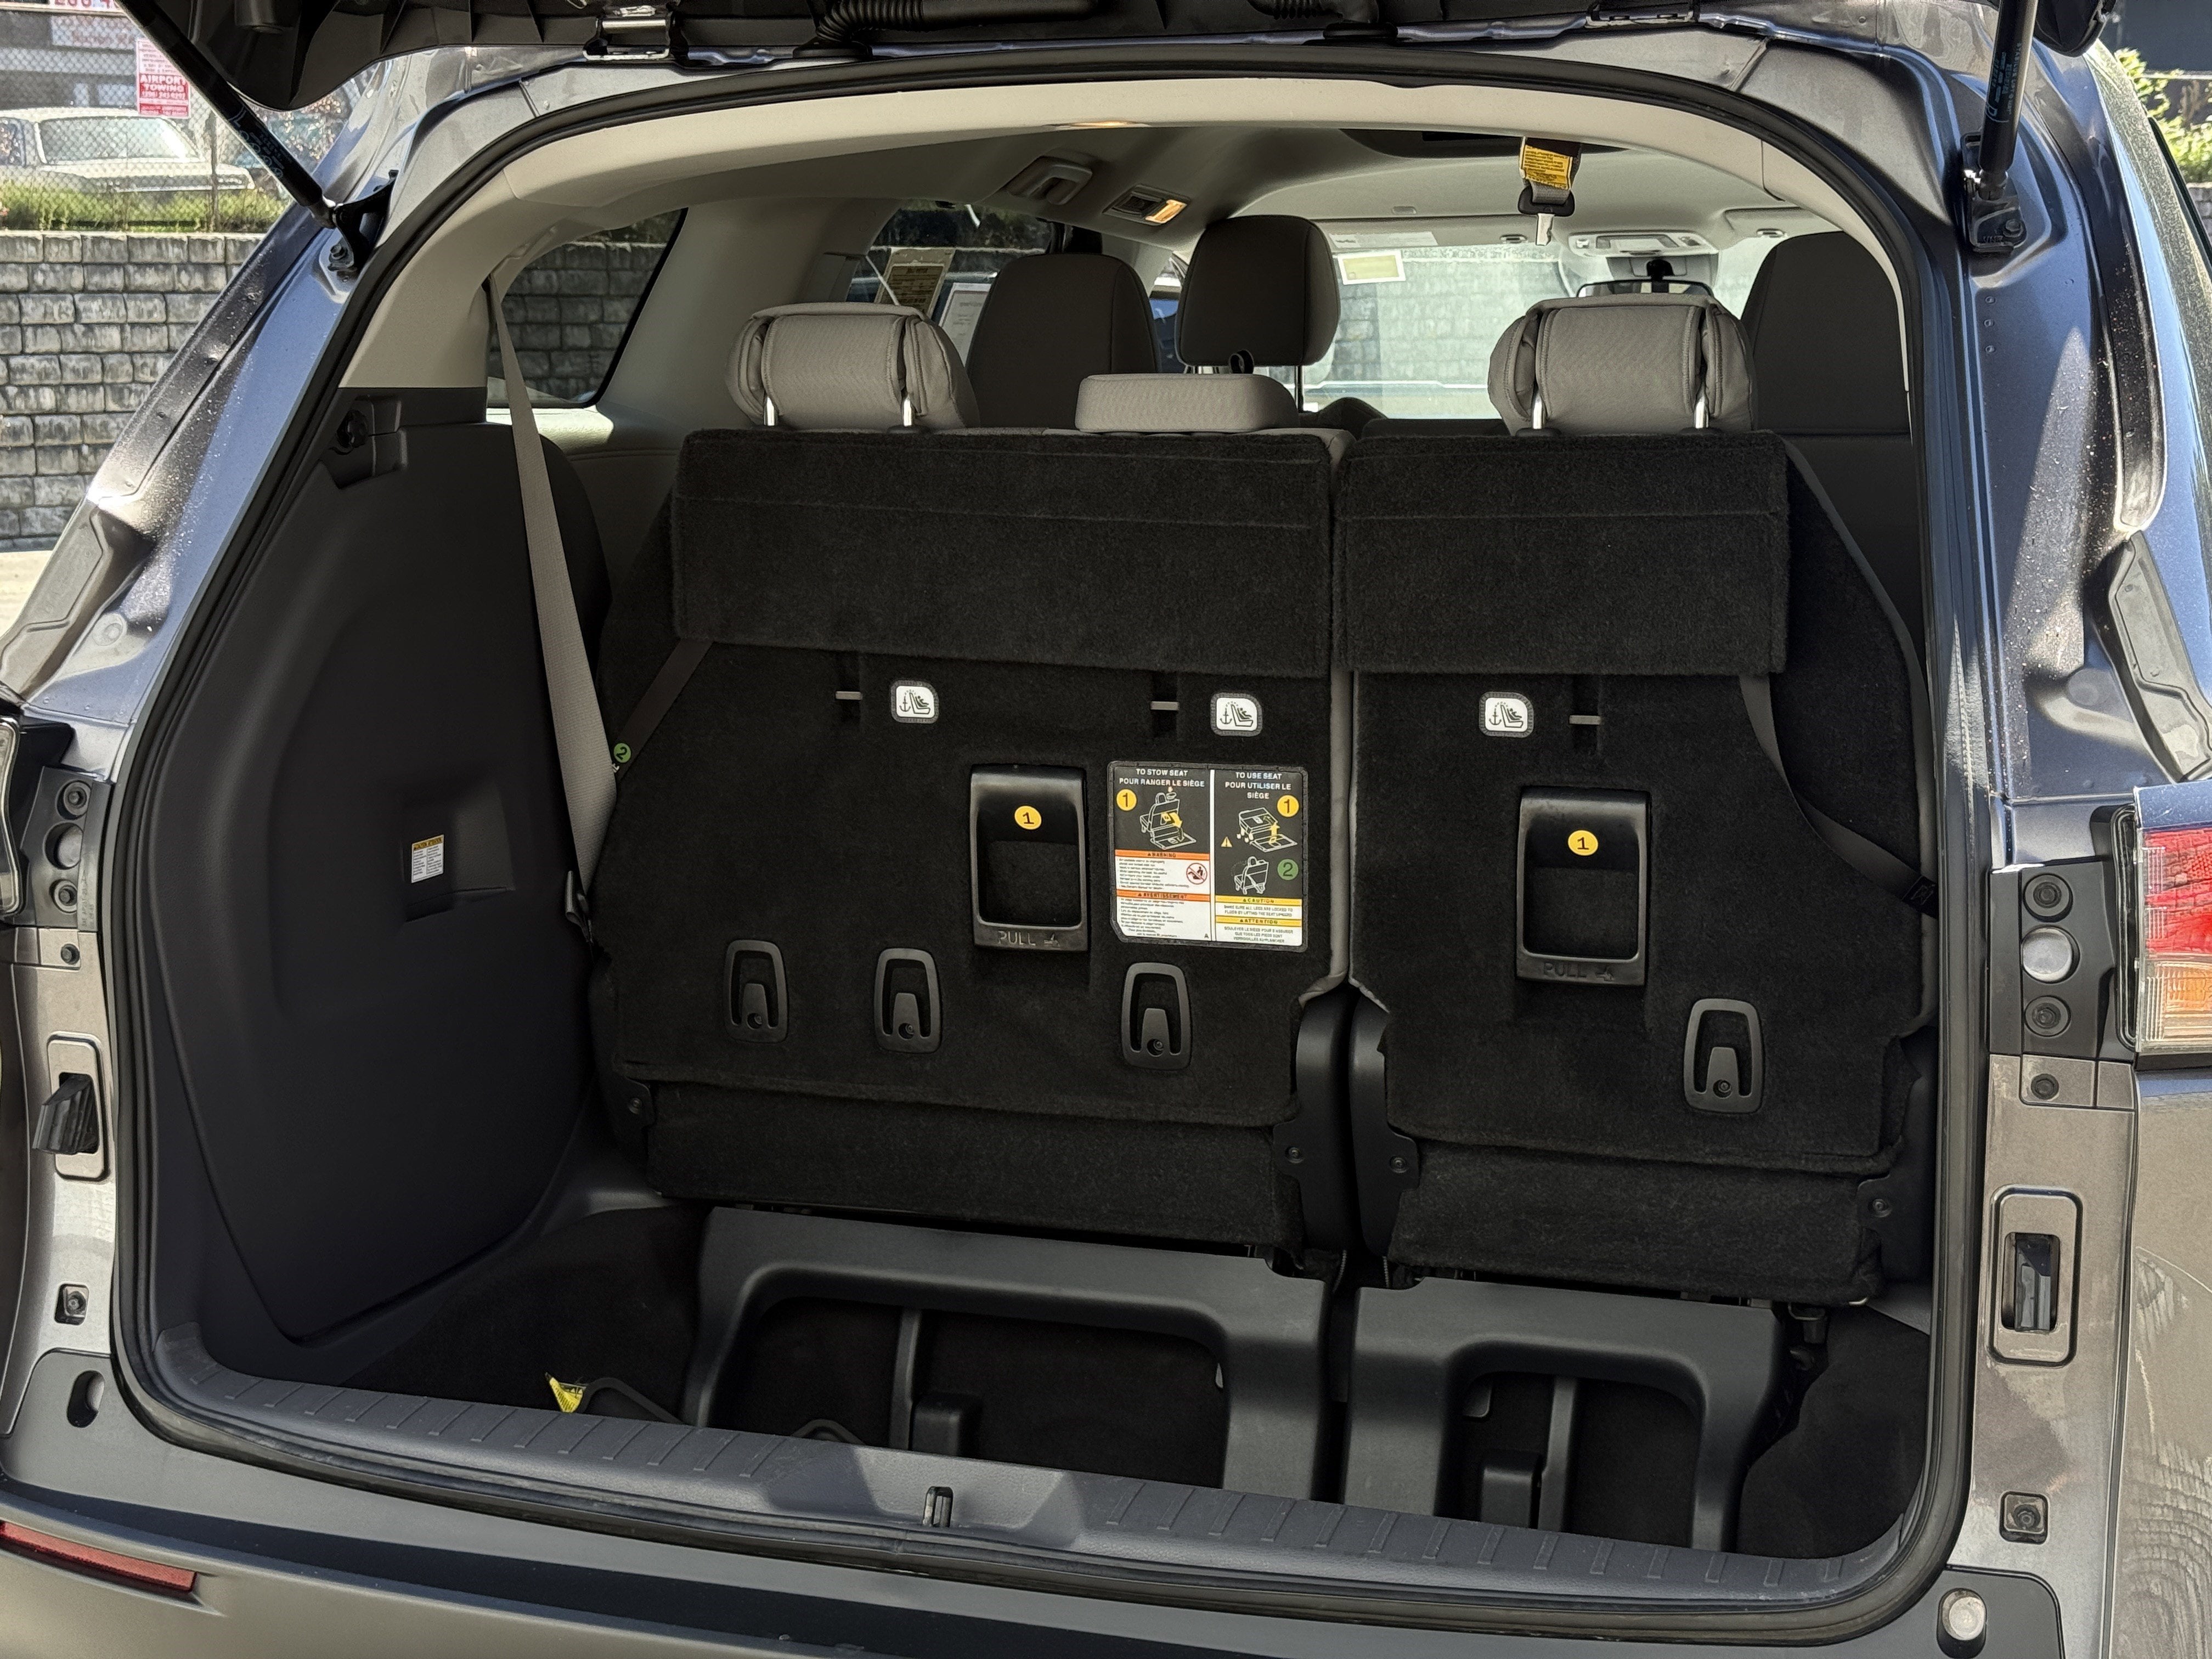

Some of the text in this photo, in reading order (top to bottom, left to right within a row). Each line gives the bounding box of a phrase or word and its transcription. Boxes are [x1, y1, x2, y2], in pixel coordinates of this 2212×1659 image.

[616, 746, 628, 760] 2
[1122, 793, 1128, 808] 1
[1247, 791, 1270, 799] SIÈGE
[1284, 799, 1290, 814] 1
[1022, 812, 1035, 825] 1
[1577, 837, 1589, 850] 1
[1283, 862, 1293, 877] 2
[997, 930, 1036, 946] PULL
[1543, 962, 1587, 979] PULL
